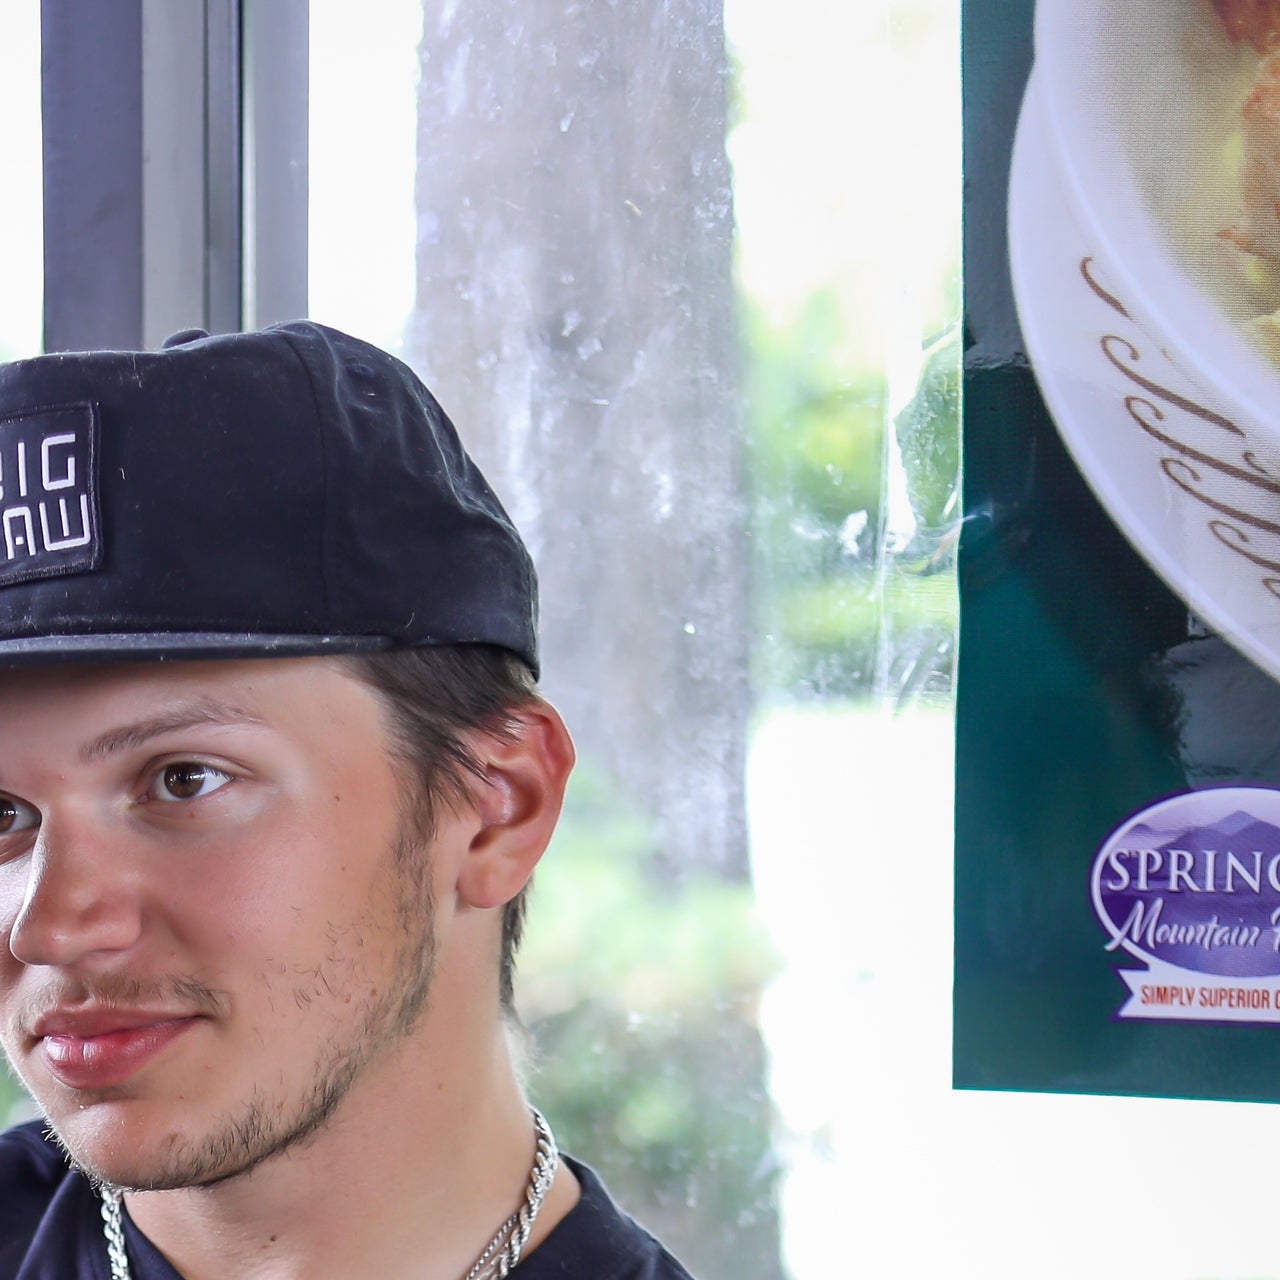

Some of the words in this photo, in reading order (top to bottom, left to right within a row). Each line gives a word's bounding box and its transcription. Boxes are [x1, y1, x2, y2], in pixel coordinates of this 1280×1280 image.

[1104, 897, 1261, 952] Mountain
[1140, 984, 1196, 1007] SIMPLY
[1199, 987, 1270, 1009] SUPERIOR
